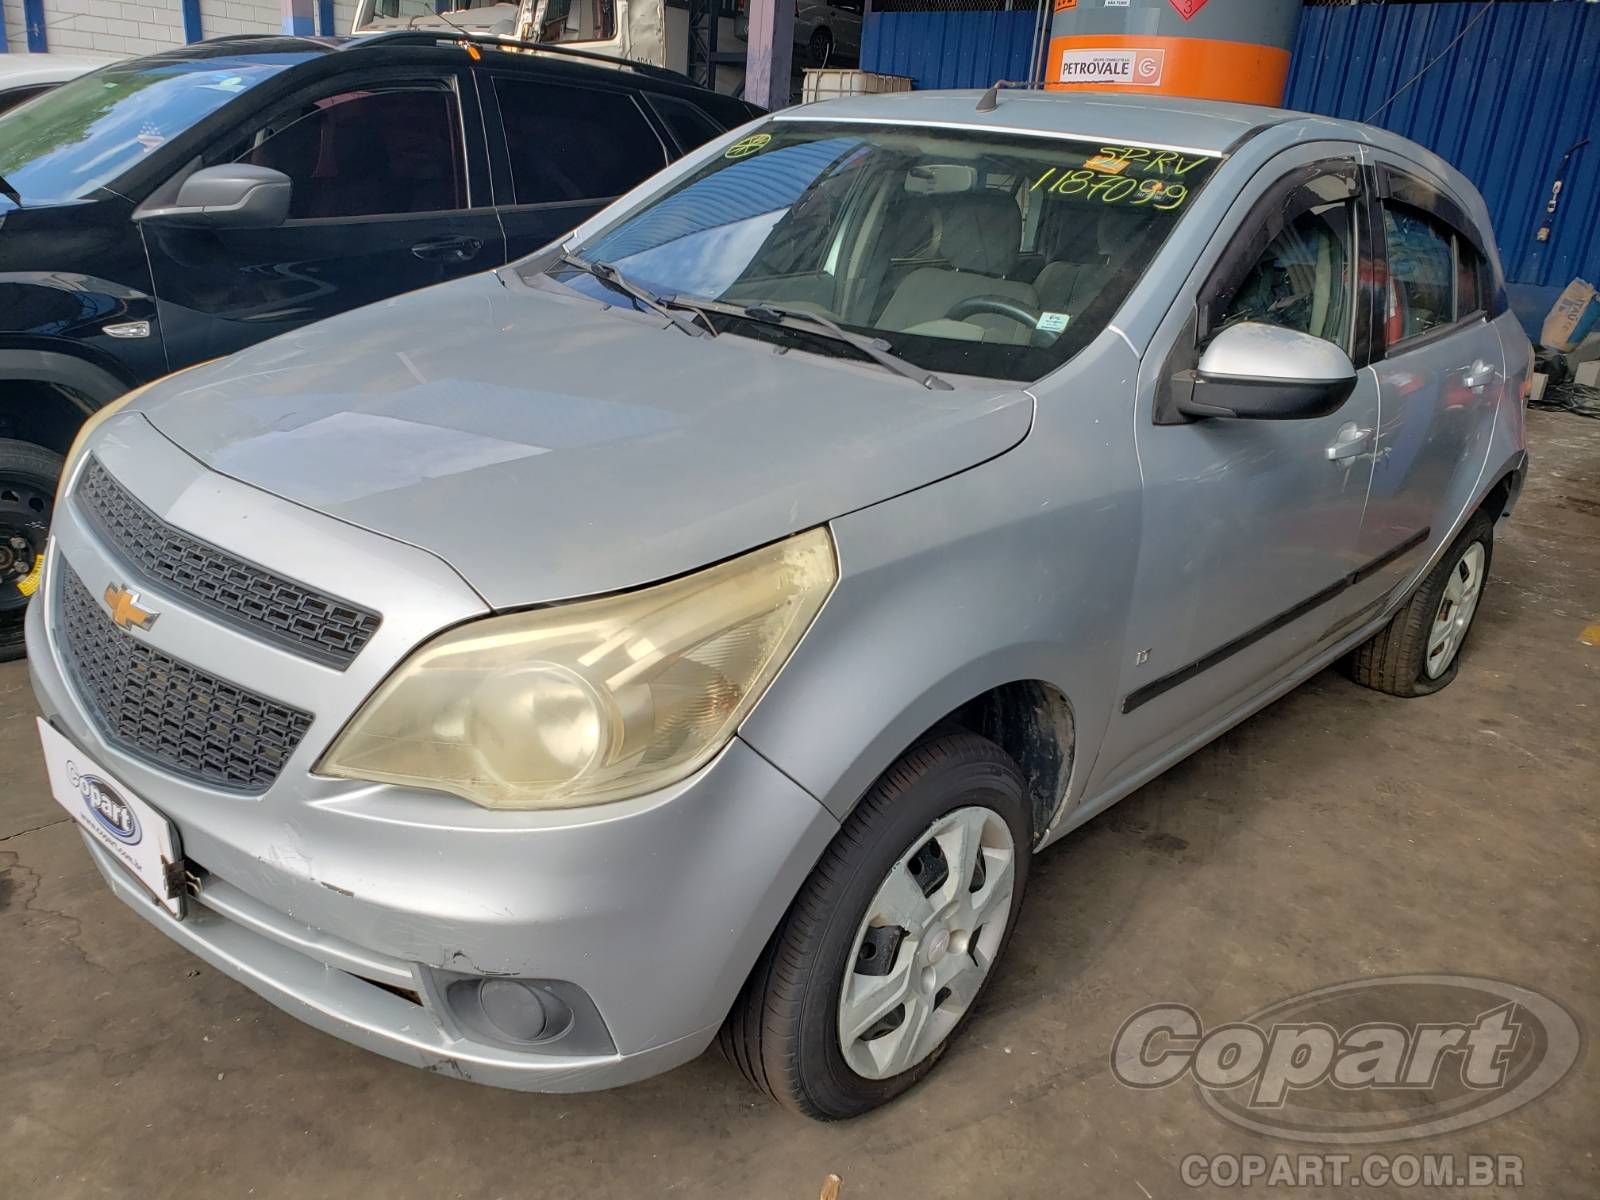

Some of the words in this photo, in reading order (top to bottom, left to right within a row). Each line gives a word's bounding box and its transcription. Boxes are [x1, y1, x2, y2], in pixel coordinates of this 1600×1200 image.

[1184, 0, 1193, 14] 3
[1062, 62, 1130, 75] PETROVALE
[1030, 167, 1189, 210] 1187099
[66, 760, 134, 831] Copart
